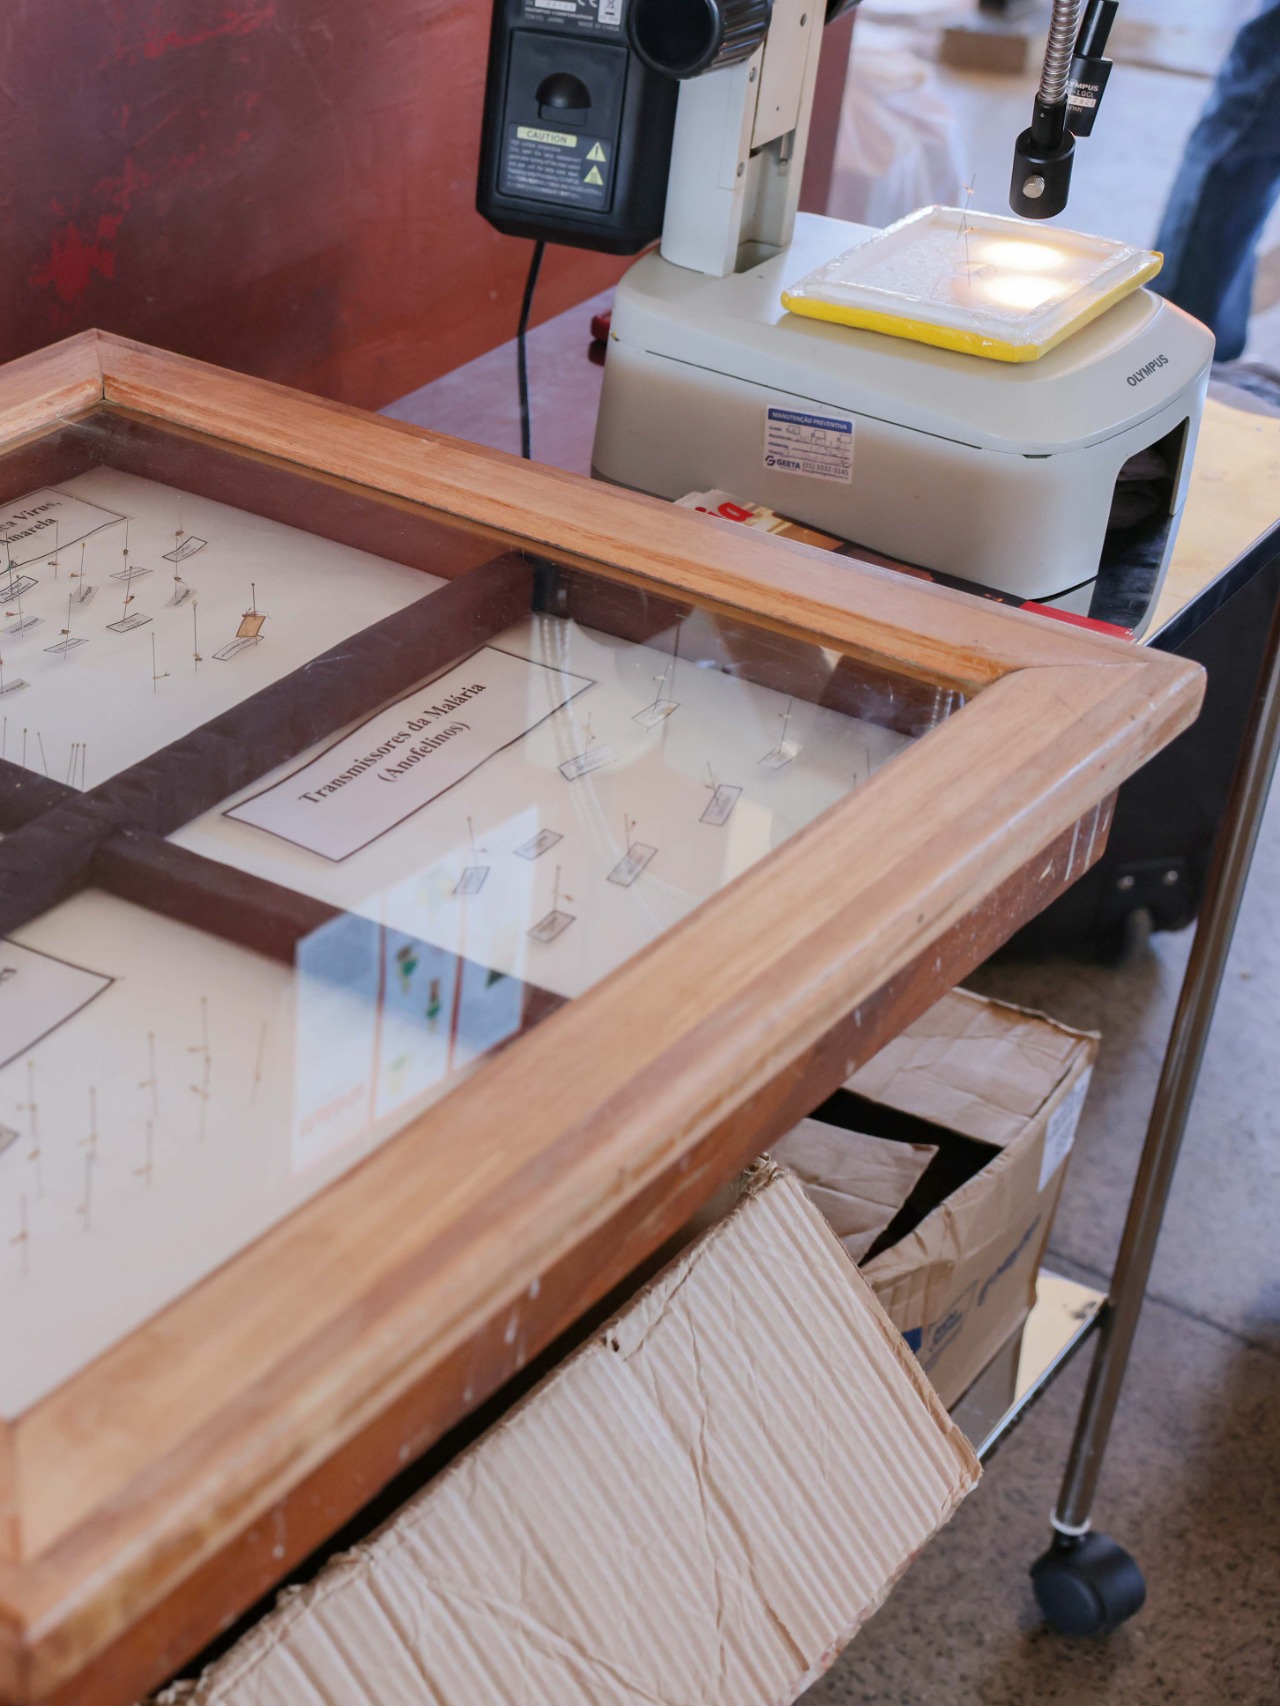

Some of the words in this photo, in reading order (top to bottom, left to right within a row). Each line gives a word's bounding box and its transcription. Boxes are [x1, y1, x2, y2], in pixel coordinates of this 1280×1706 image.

[526, 130, 567, 144] CAUTION
[1126, 354, 1169, 387] OLYMPUS
[297, 730, 412, 804] Transmissores
[407, 716, 432, 732] da
[423, 682, 487, 720] Malária
[377, 721, 471, 783] (Anofelinos)
